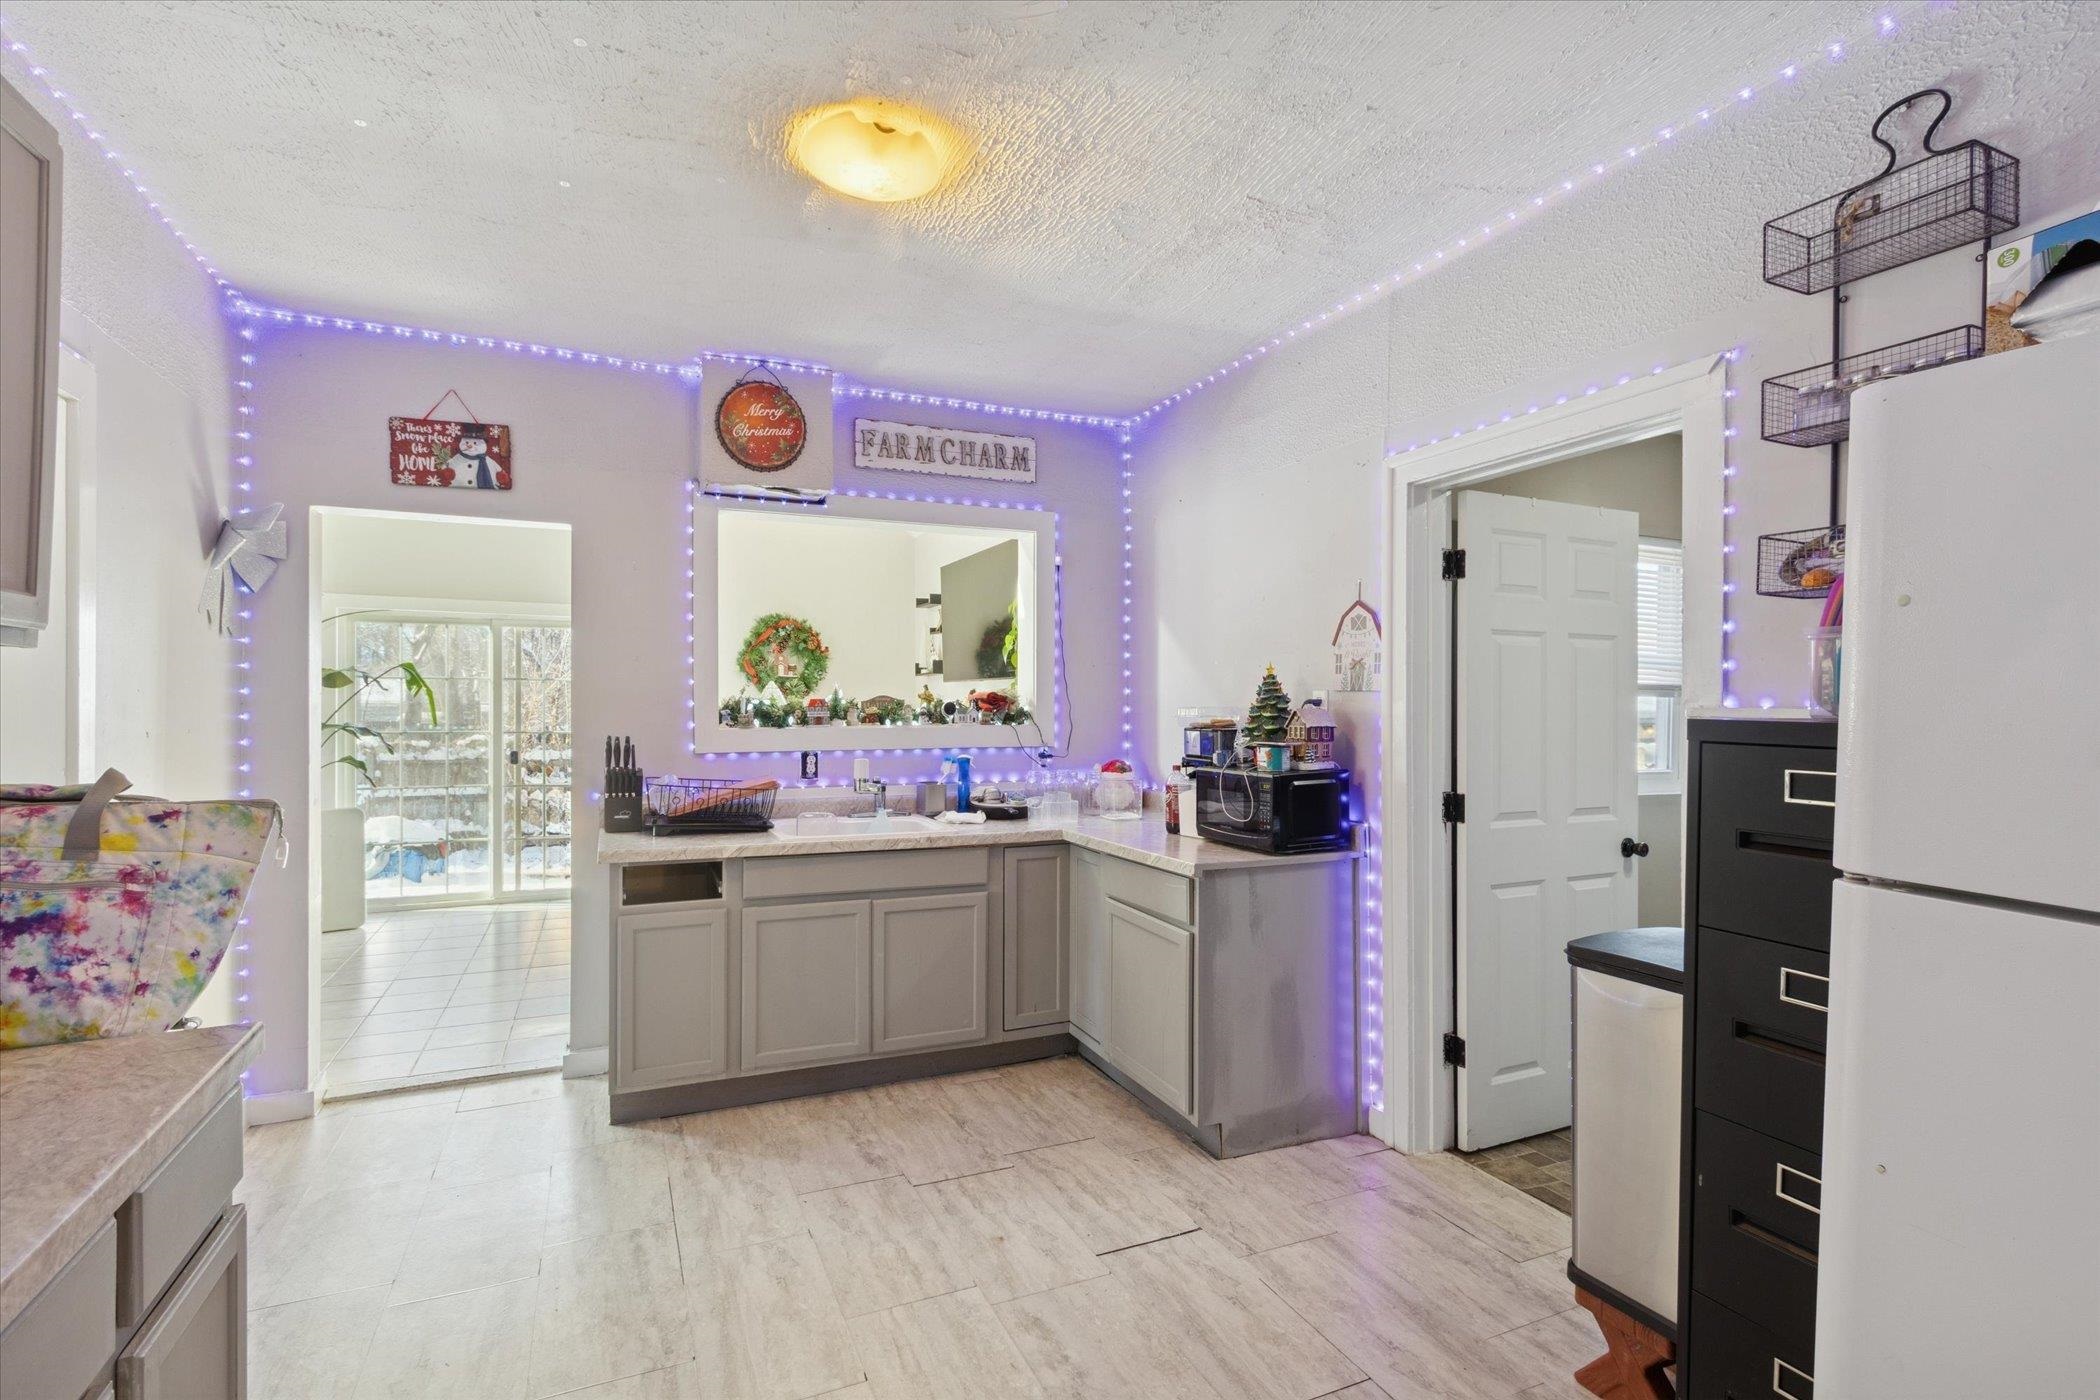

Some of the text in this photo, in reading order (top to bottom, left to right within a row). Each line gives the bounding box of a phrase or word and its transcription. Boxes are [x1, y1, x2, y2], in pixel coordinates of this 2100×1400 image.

[744, 403, 783, 420] Merry
[732, 422, 794, 437] Christmas
[399, 453, 437, 471] HOME
